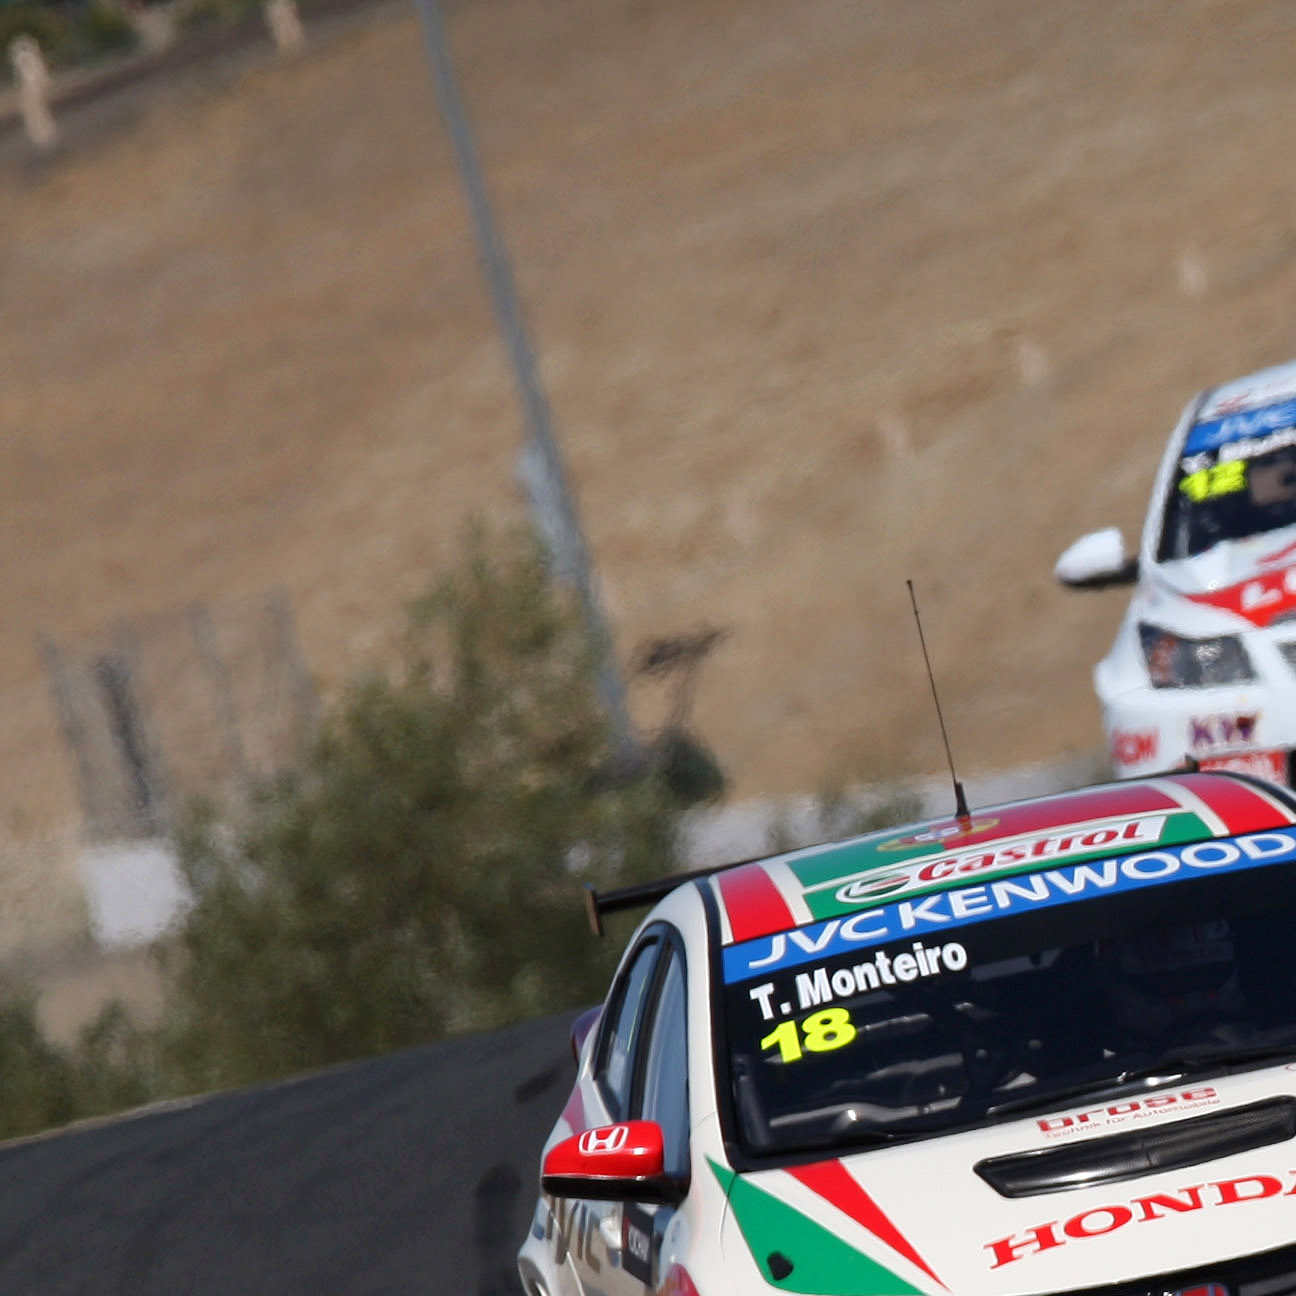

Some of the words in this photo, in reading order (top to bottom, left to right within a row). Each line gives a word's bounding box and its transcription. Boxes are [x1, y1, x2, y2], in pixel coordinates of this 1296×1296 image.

[917, 821, 1147, 883] Castrol
[795, 942, 968, 1010] Monteiro
[760, 1007, 858, 1064] 18
[1036, 1087, 1217, 1132] brose
